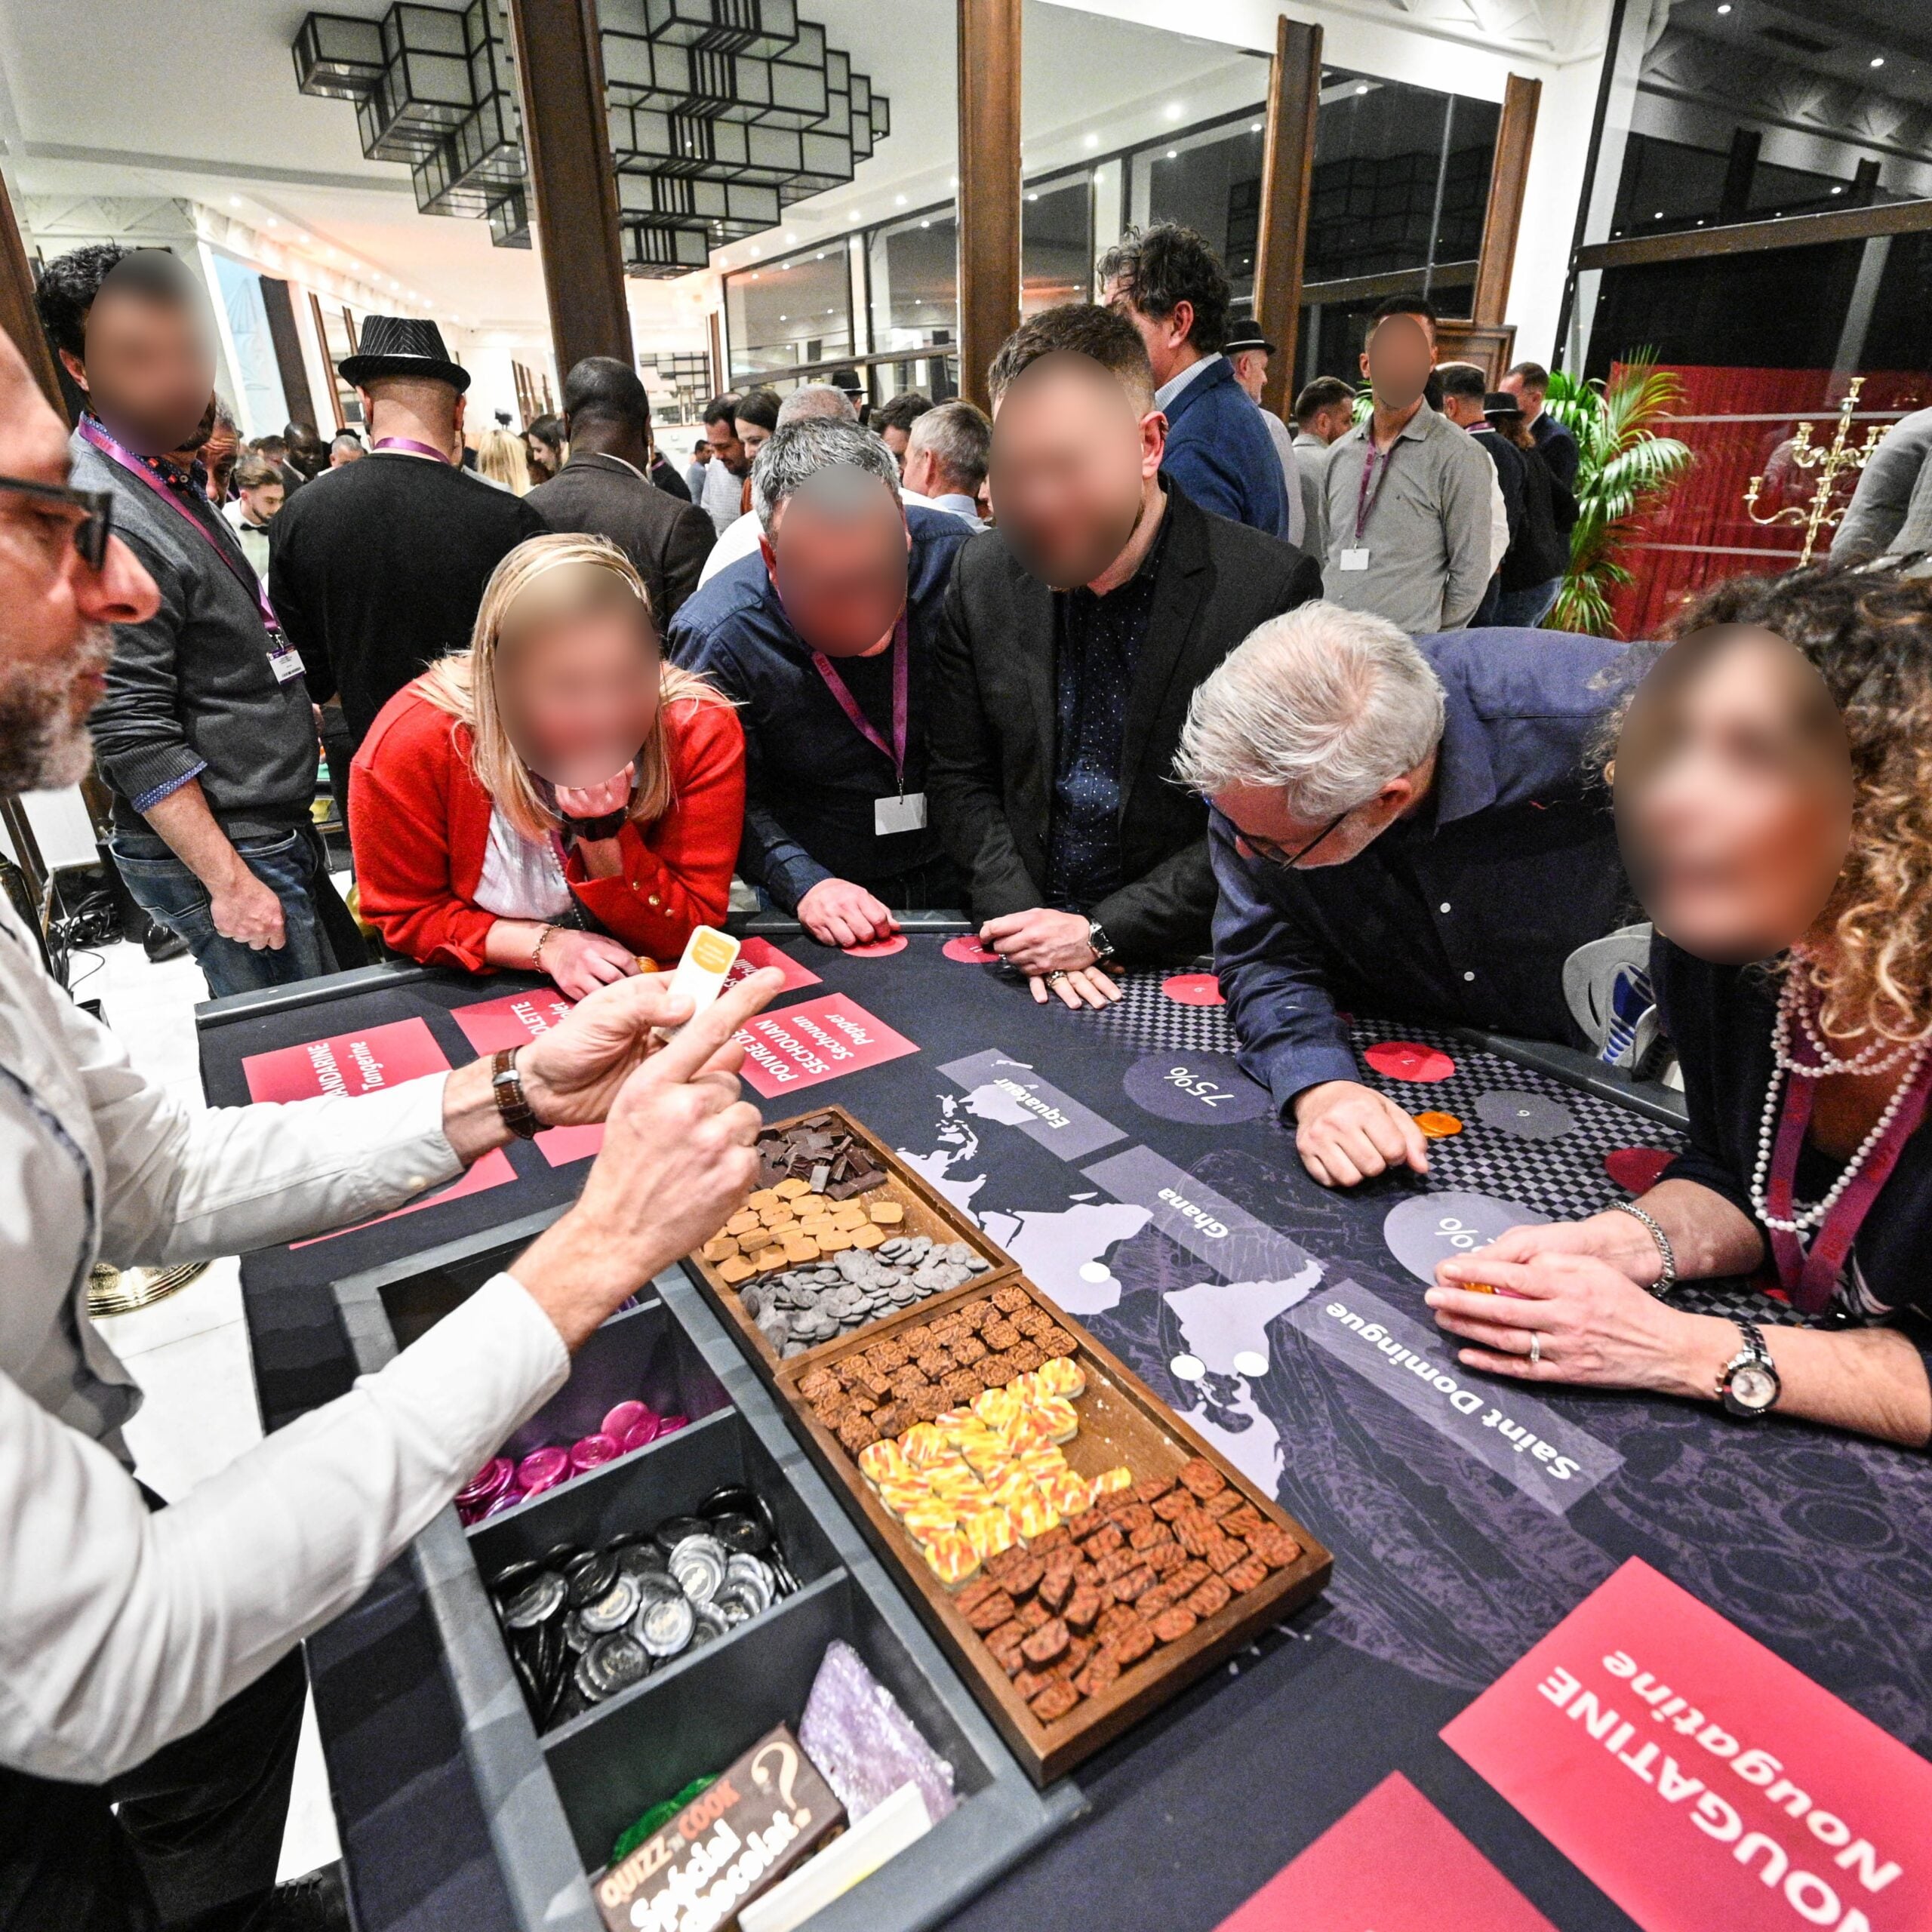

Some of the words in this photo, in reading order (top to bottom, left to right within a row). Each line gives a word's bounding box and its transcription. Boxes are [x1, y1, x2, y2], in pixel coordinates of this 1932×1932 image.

[510, 1001, 549, 1035] OLETTE
[792, 1016, 854, 1060] Sechouan
[825, 1014, 875, 1045] Pepper
[306, 1042, 349, 1097] ANDARINE
[348, 1041, 385, 1091] Tangerine
[743, 1042, 799, 1082] POIVRE
[755, 1019, 831, 1075] SECHOUAN
[992, 1078, 1071, 1129] Equateur
[1164, 1066, 1235, 1107] 75%
[1158, 1187, 1229, 1238] Ghana
[1325, 1302, 1484, 1415] Domingue
[1481, 1407, 1581, 1480] Saint
[1601, 1650, 1903, 1894] Nougatine
[601, 1835, 673, 1907] QUIZZ
[678, 1780, 741, 1840] COOK
